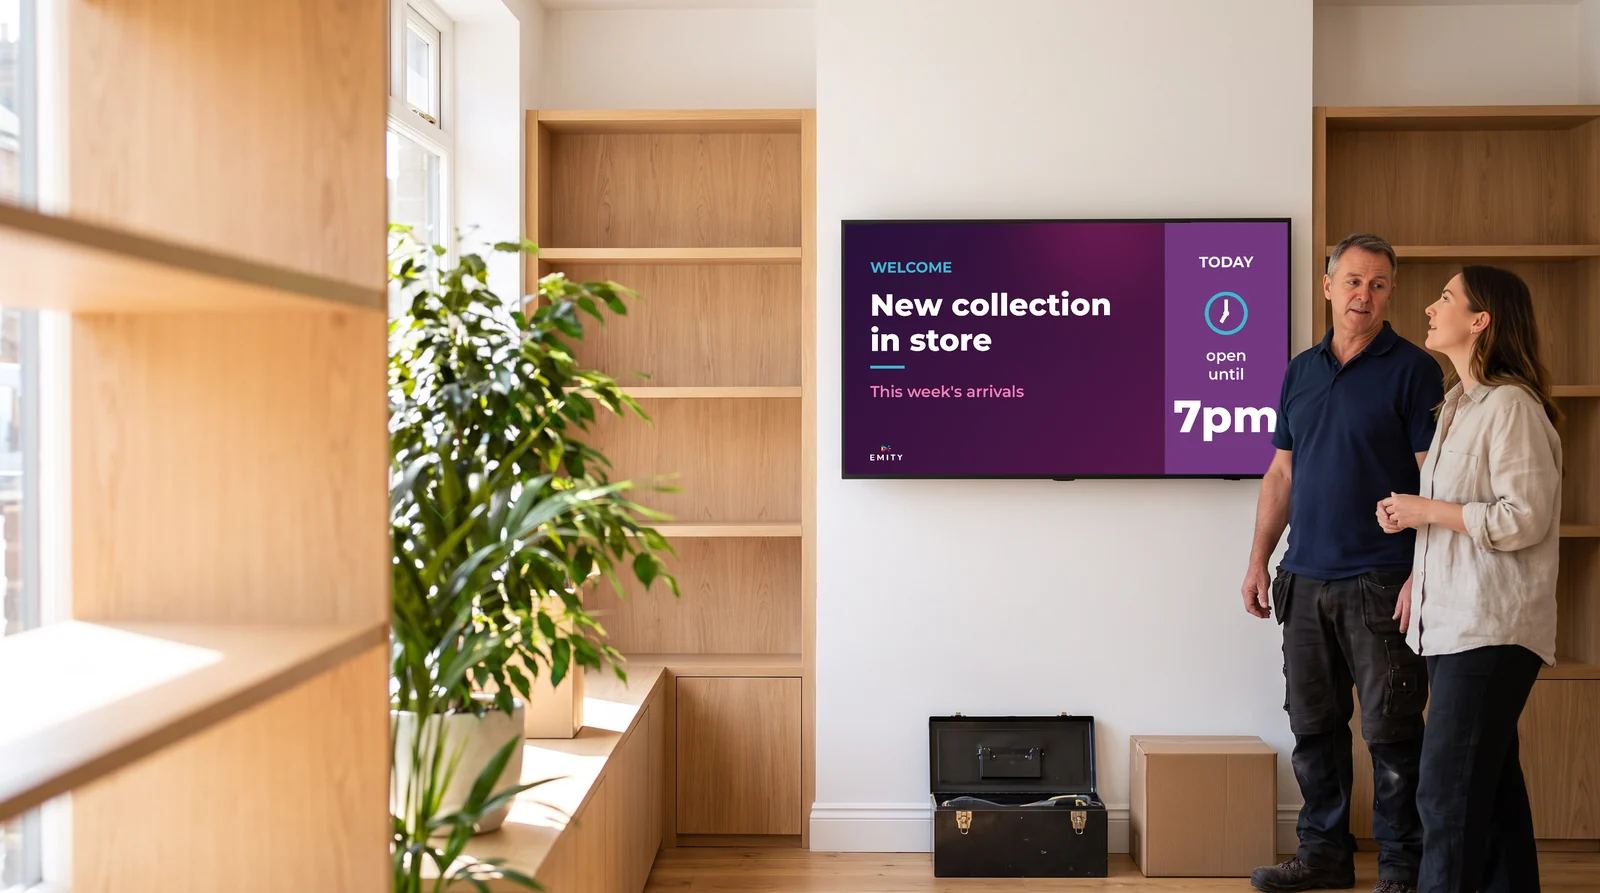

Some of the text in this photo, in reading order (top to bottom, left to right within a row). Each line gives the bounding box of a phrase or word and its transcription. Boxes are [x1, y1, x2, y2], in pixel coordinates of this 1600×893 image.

[870, 262, 953, 273] WELCOME
[1199, 256, 1254, 268] TODAY
[871, 290, 1111, 317] New collection
[870, 326, 993, 352] in store
[1206, 351, 1247, 365] open
[1208, 367, 1245, 381] until
[870, 385, 1025, 398] This week's arrivals
[1173, 399, 1277, 442] 7pm
